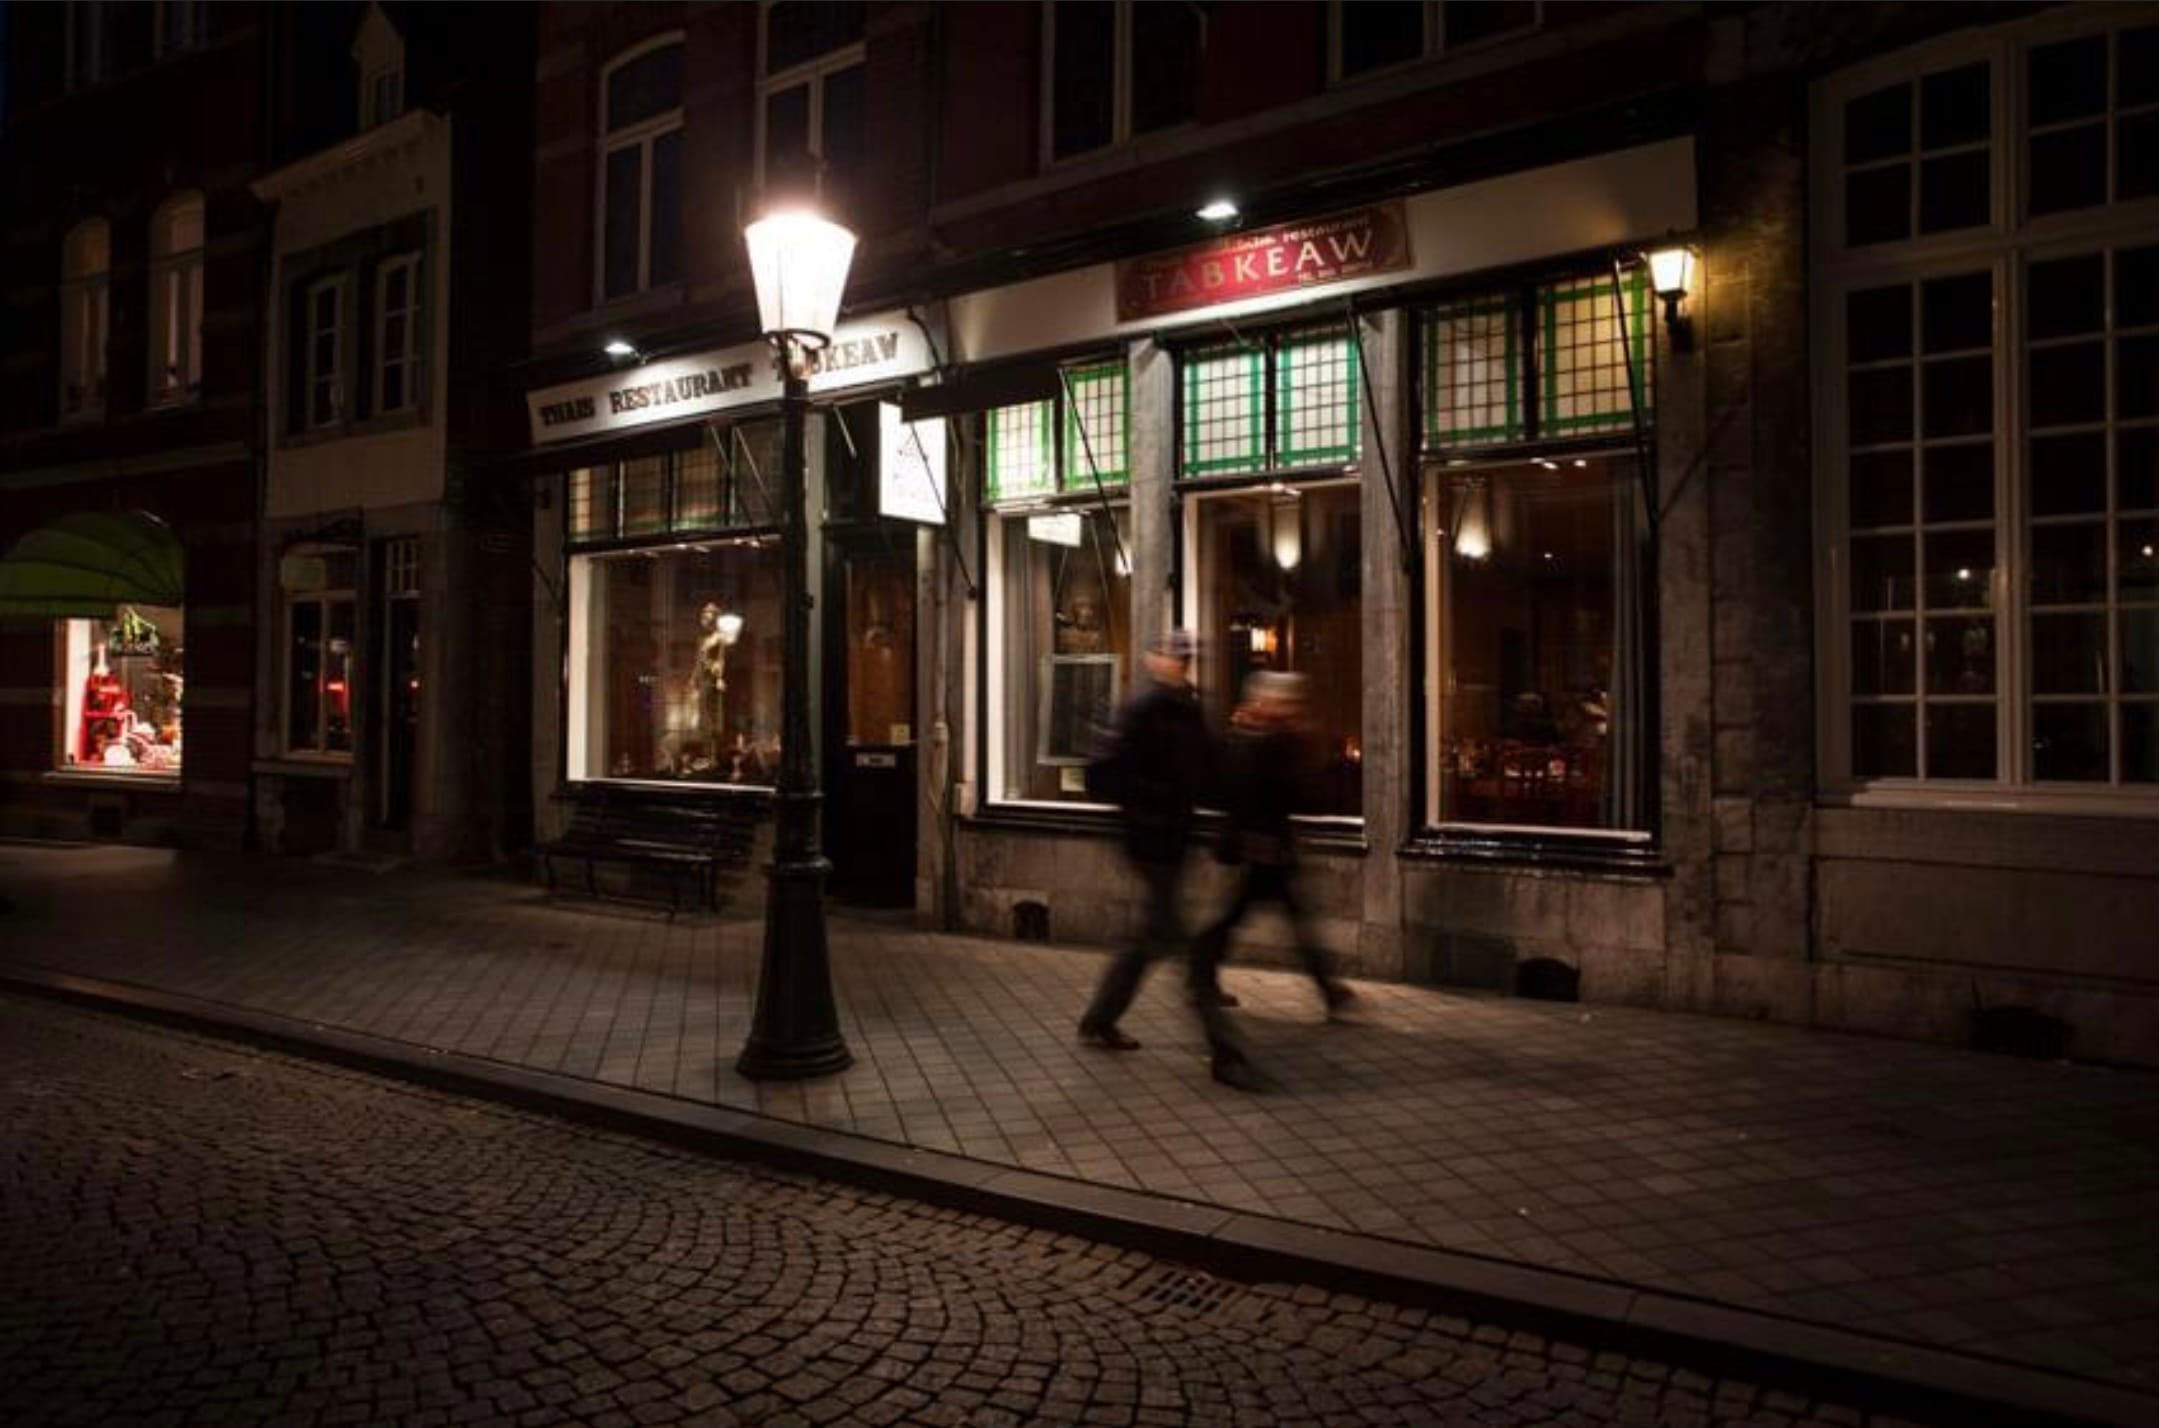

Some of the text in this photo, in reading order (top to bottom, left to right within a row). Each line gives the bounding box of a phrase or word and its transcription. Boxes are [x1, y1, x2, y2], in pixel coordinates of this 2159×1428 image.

[1140, 228, 1374, 300] TABKEAW
[609, 363, 753, 414] RESTAURANT
[771, 331, 899, 382] KEAW
